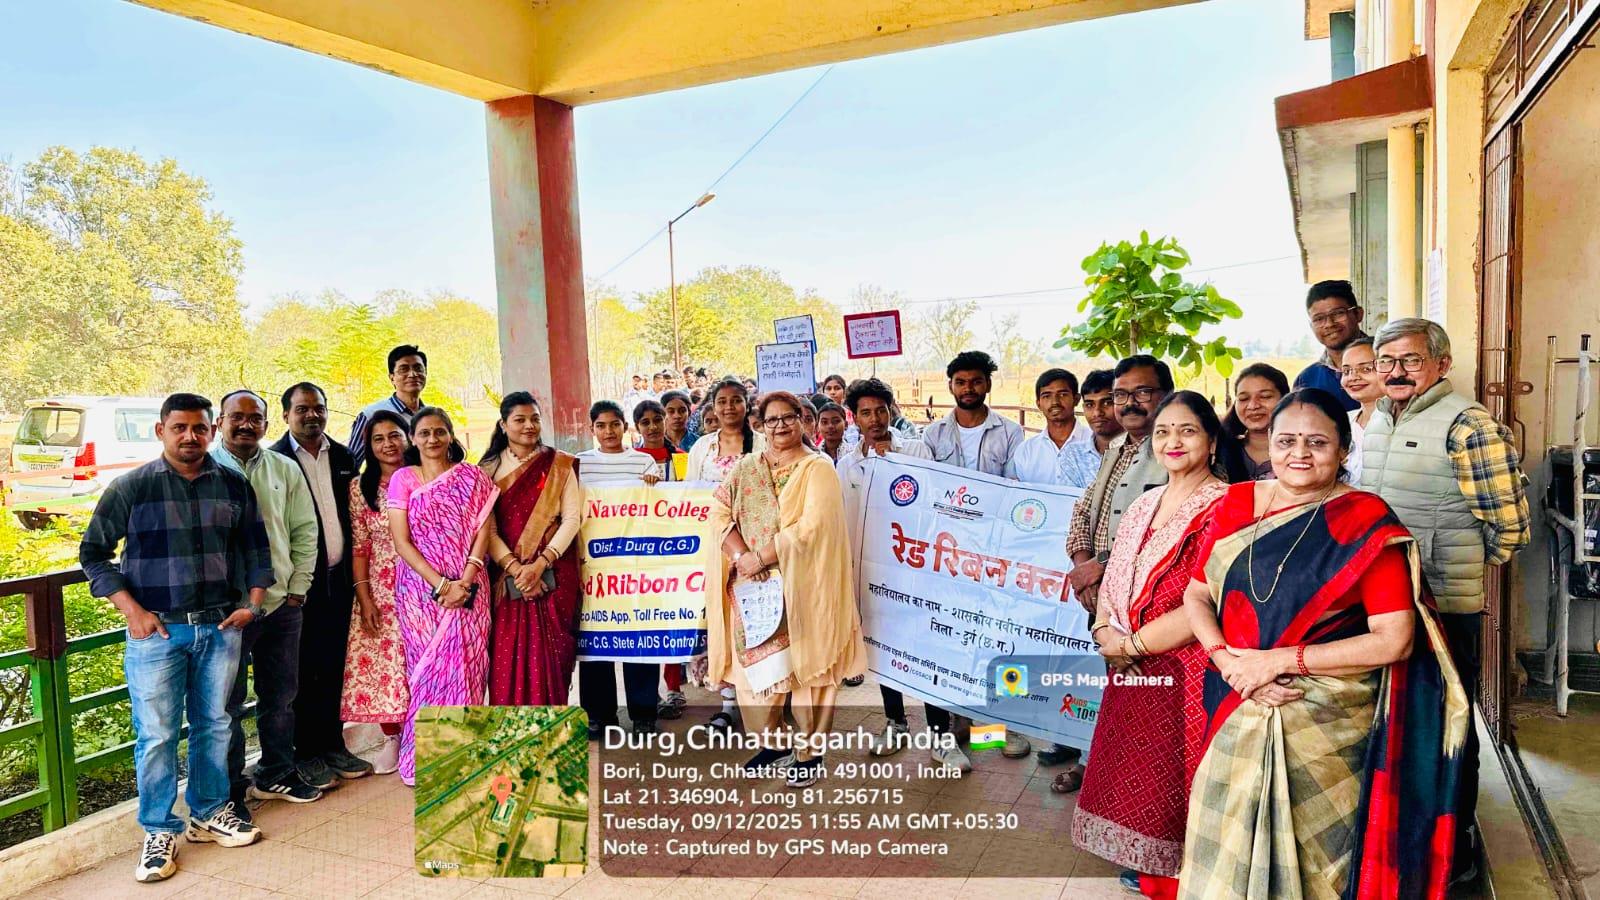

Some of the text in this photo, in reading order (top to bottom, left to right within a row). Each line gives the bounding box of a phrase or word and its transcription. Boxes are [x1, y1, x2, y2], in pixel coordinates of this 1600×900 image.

[587, 499, 711, 522] Naveen Colleg
[593, 542, 614, 554] Dist.
[625, 540, 655, 553] Durg
[659, 539, 695, 554] (C.G.)
[891, 521, 1071, 603] रेड रिबन क्ल
[607, 572, 679, 596] Ribbon
[633, 608, 651, 621] Toll
[654, 608, 676, 620] Free
[679, 607, 697, 619] No.
[912, 596, 924, 609] का
[925, 599, 942, 614] नाम
[952, 607, 994, 628] शासकीय
[995, 618, 1024, 636] नवीन
[1025, 627, 1091, 652] महाविद्यालय
[613, 636, 634, 649] Stete
[637, 635, 660, 649] AIDS
[663, 634, 698, 649] Control
[930, 617, 953, 637] जिला
[961, 628, 977, 646] दुर्ग
